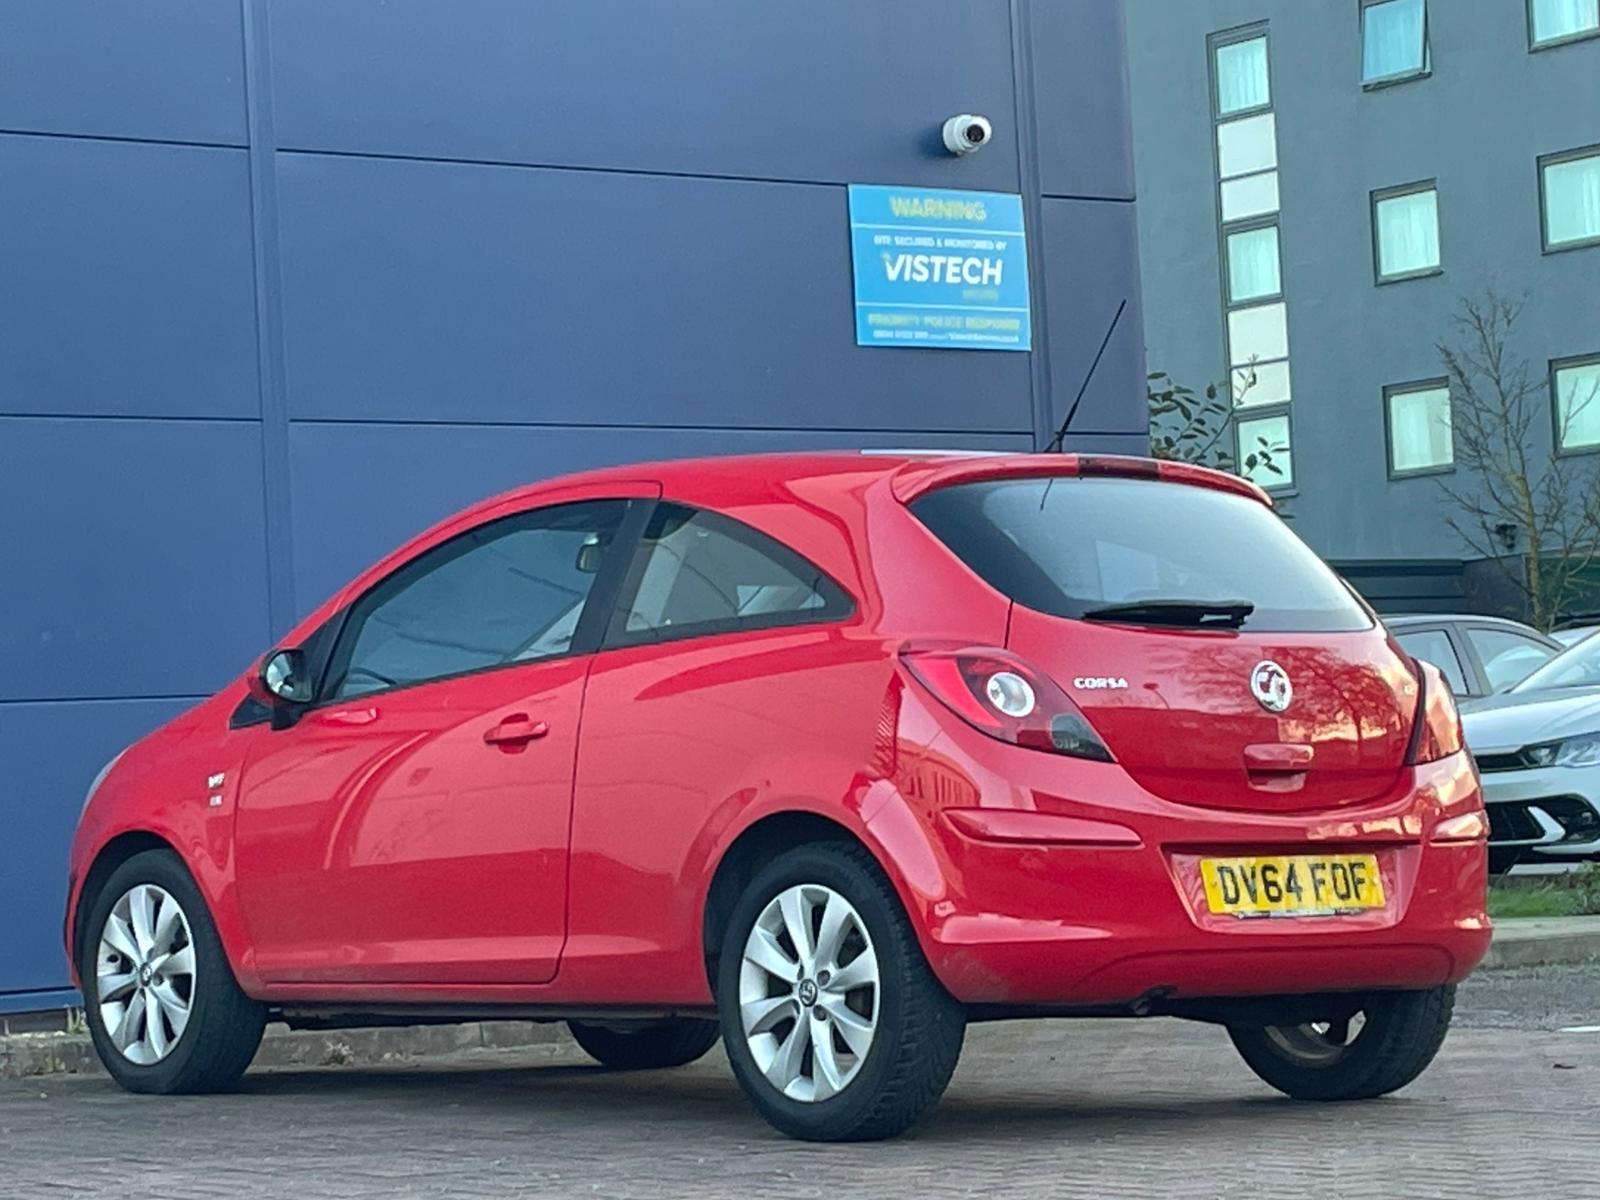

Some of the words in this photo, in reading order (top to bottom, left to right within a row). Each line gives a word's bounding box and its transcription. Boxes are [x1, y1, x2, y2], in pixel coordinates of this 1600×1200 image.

[889, 196, 987, 222] WARNING
[884, 254, 1003, 286] VISTECH
[1073, 677, 1128, 689] CORSA
[1217, 863, 1304, 905] DV64
